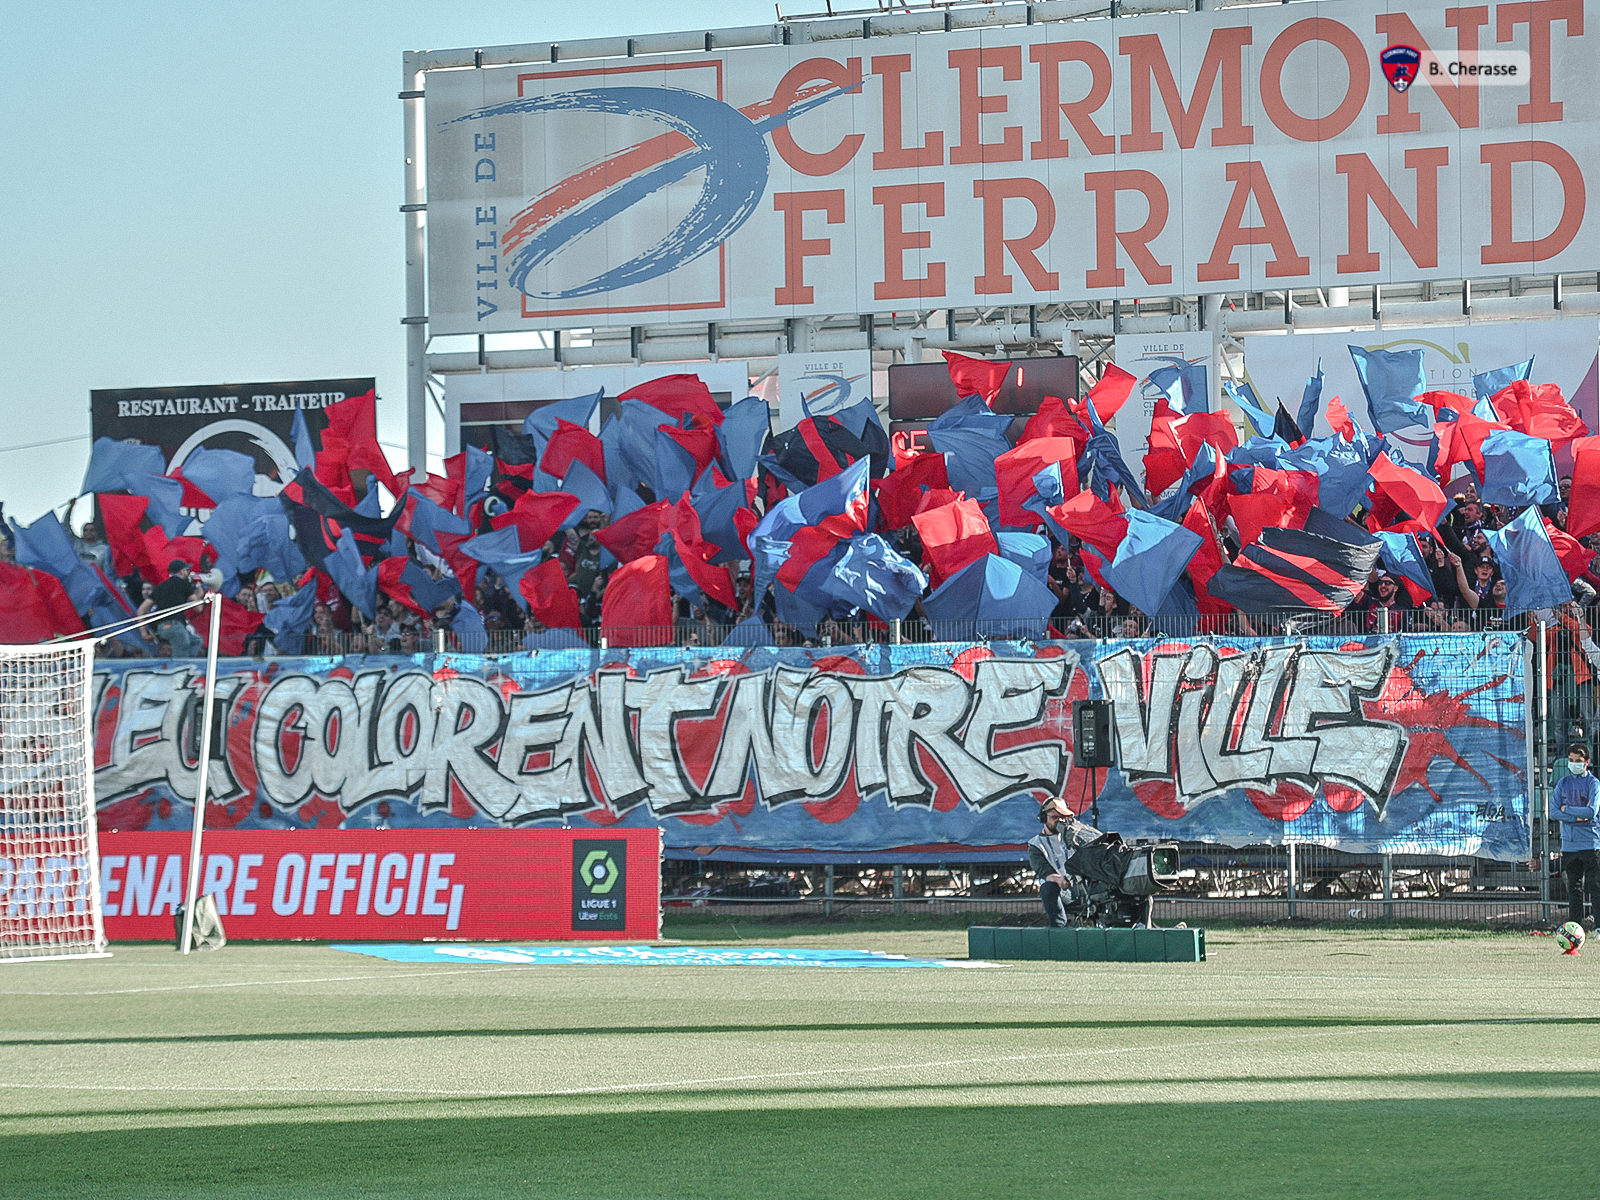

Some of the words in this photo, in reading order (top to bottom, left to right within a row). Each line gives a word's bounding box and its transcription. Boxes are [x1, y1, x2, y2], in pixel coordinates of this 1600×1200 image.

[769, 0, 1585, 177] CLERMONT
[474, 132, 497, 184] DE
[772, 140, 1586, 306] FERRAND
[475, 206, 499, 322] VILLE
[1142, 344, 1169, 352] VILLE
[1173, 343, 1185, 351] DE
[804, 363, 829, 371] VILLE
[118, 396, 239, 418] RESTAURANT
[256, 665, 731, 825] COLORENT
[694, 659, 1080, 812] NOTRE
[578, 911, 599, 921] Uber
[581, 899, 610, 909] LIGUE
